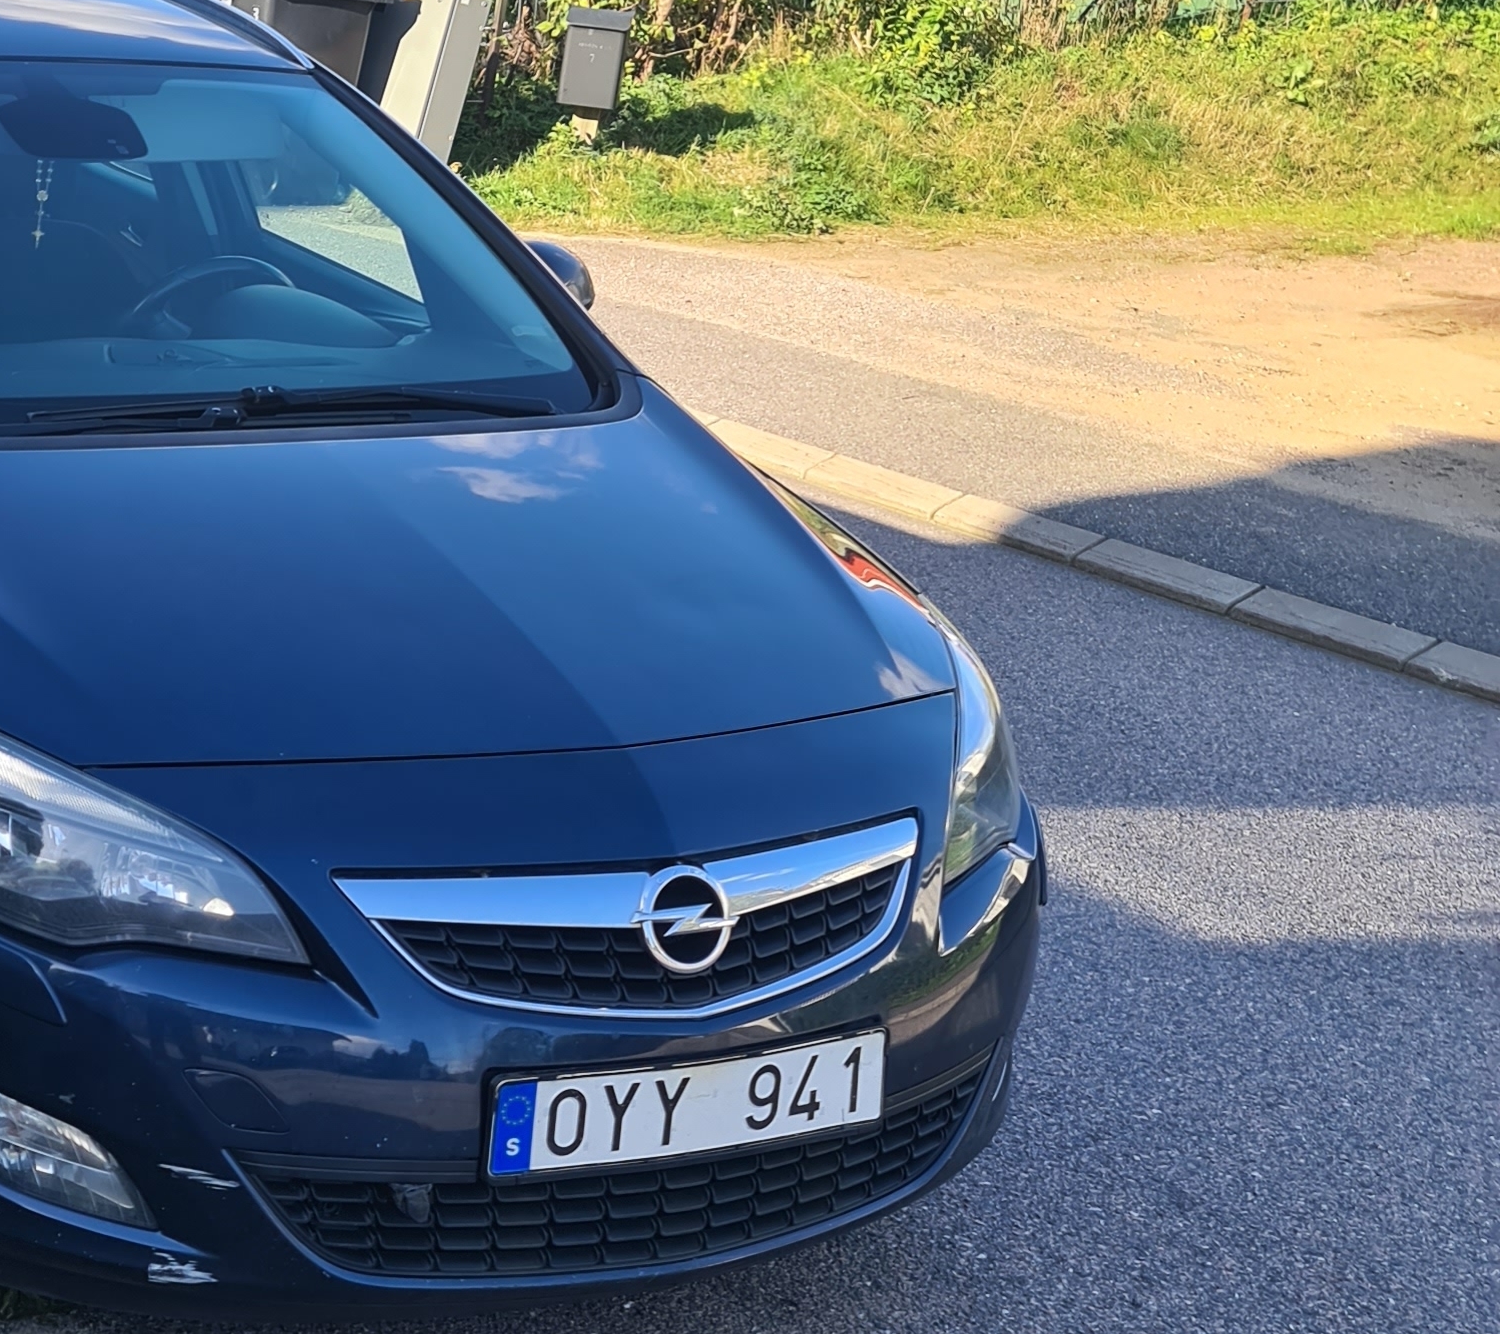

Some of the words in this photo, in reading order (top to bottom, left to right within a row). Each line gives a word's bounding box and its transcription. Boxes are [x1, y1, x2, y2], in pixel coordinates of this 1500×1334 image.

[546, 1077, 691, 1156] OYY
[745, 1046, 862, 1130] 941
[506, 1137, 520, 1156] S
